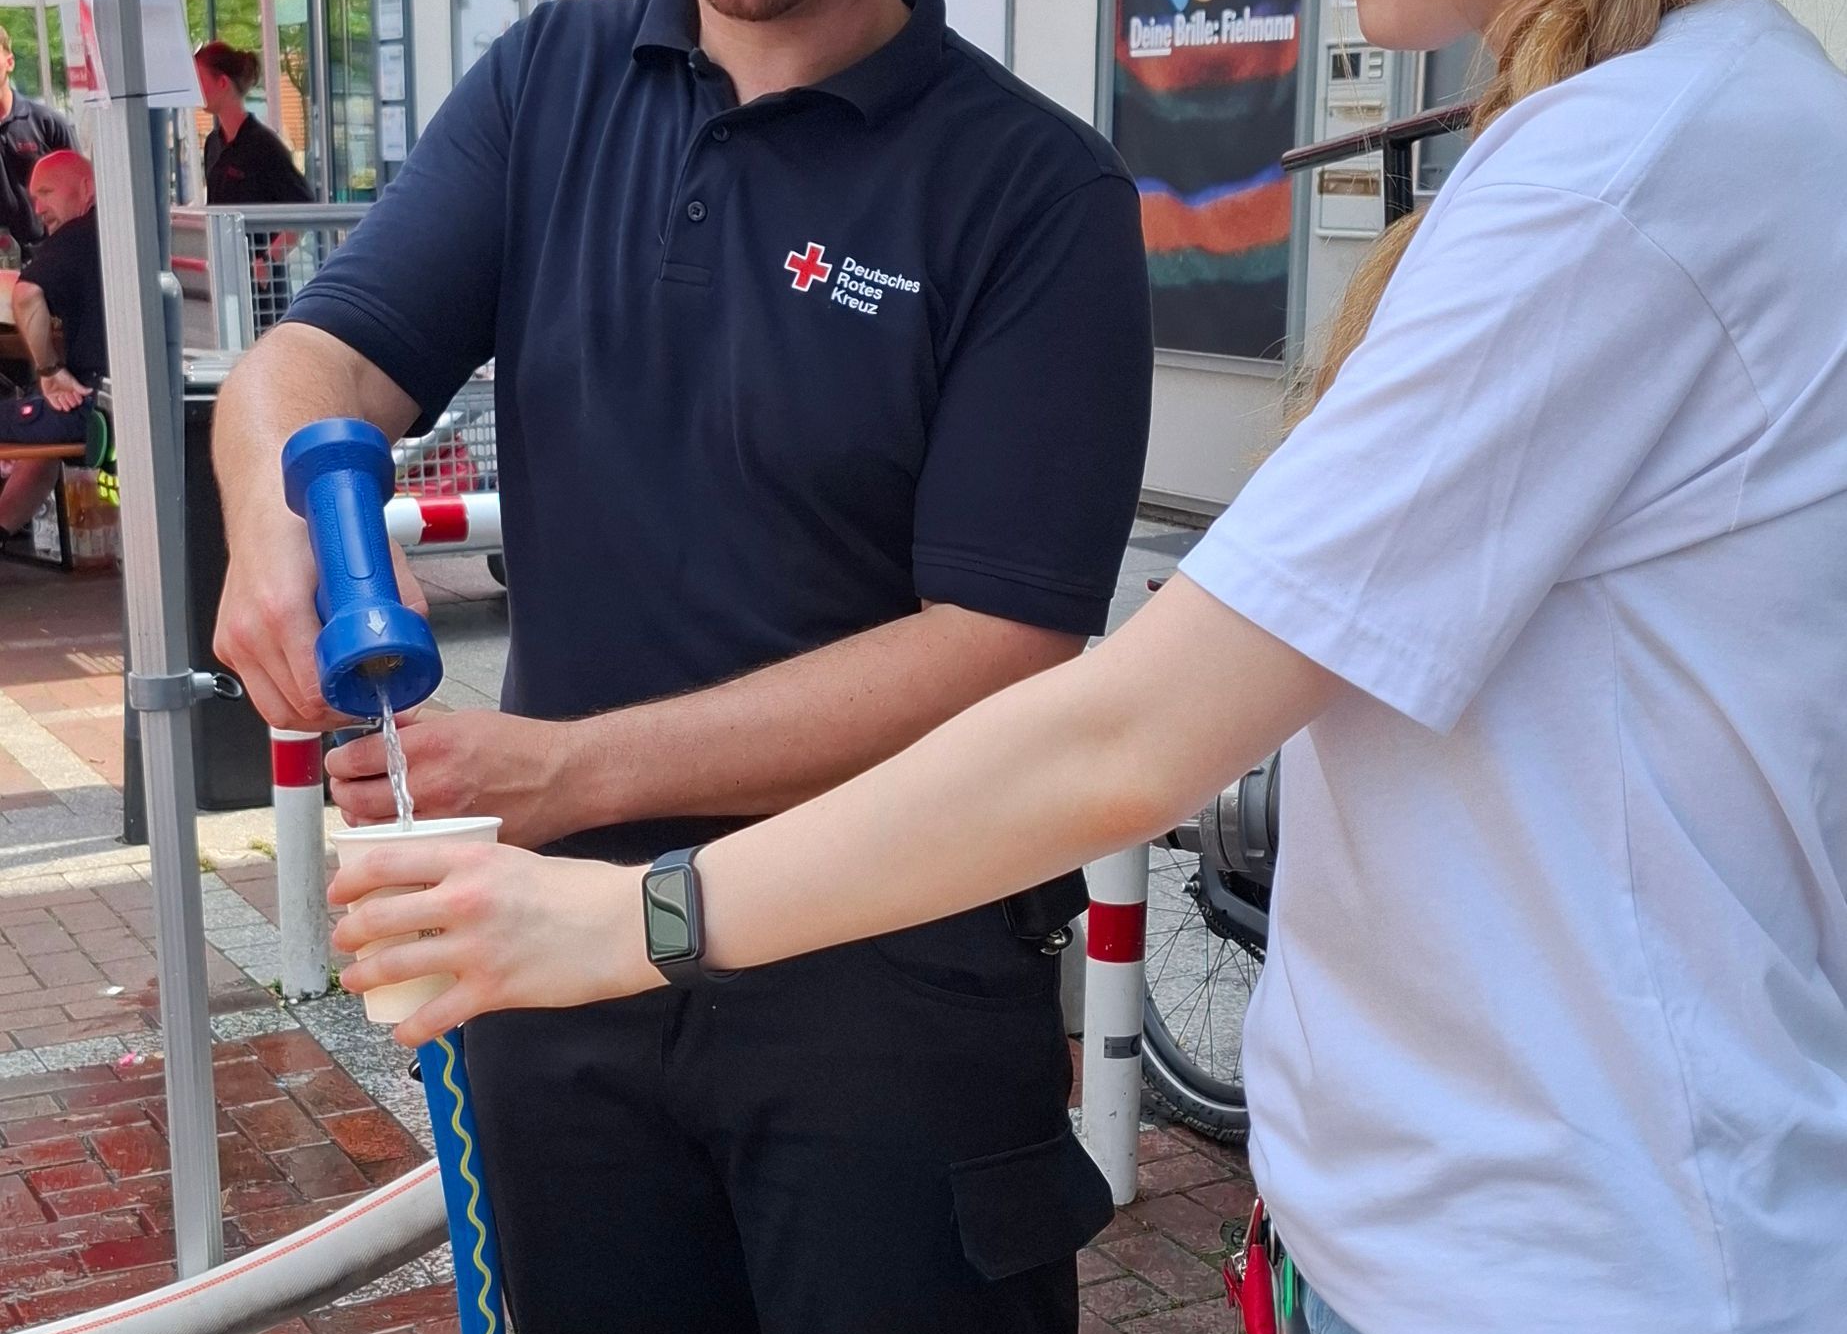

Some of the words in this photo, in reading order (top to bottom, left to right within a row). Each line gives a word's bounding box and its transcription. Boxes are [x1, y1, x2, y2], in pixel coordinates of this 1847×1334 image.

[1129, 16, 1173, 50] Deine
[1173, 8, 1220, 47] Brille:
[1220, 6, 1296, 44] Fielmann
[836, 271, 883, 301] Rotes
[841, 256, 921, 294] Deutsches
[830, 286, 879, 315] Kreuz
